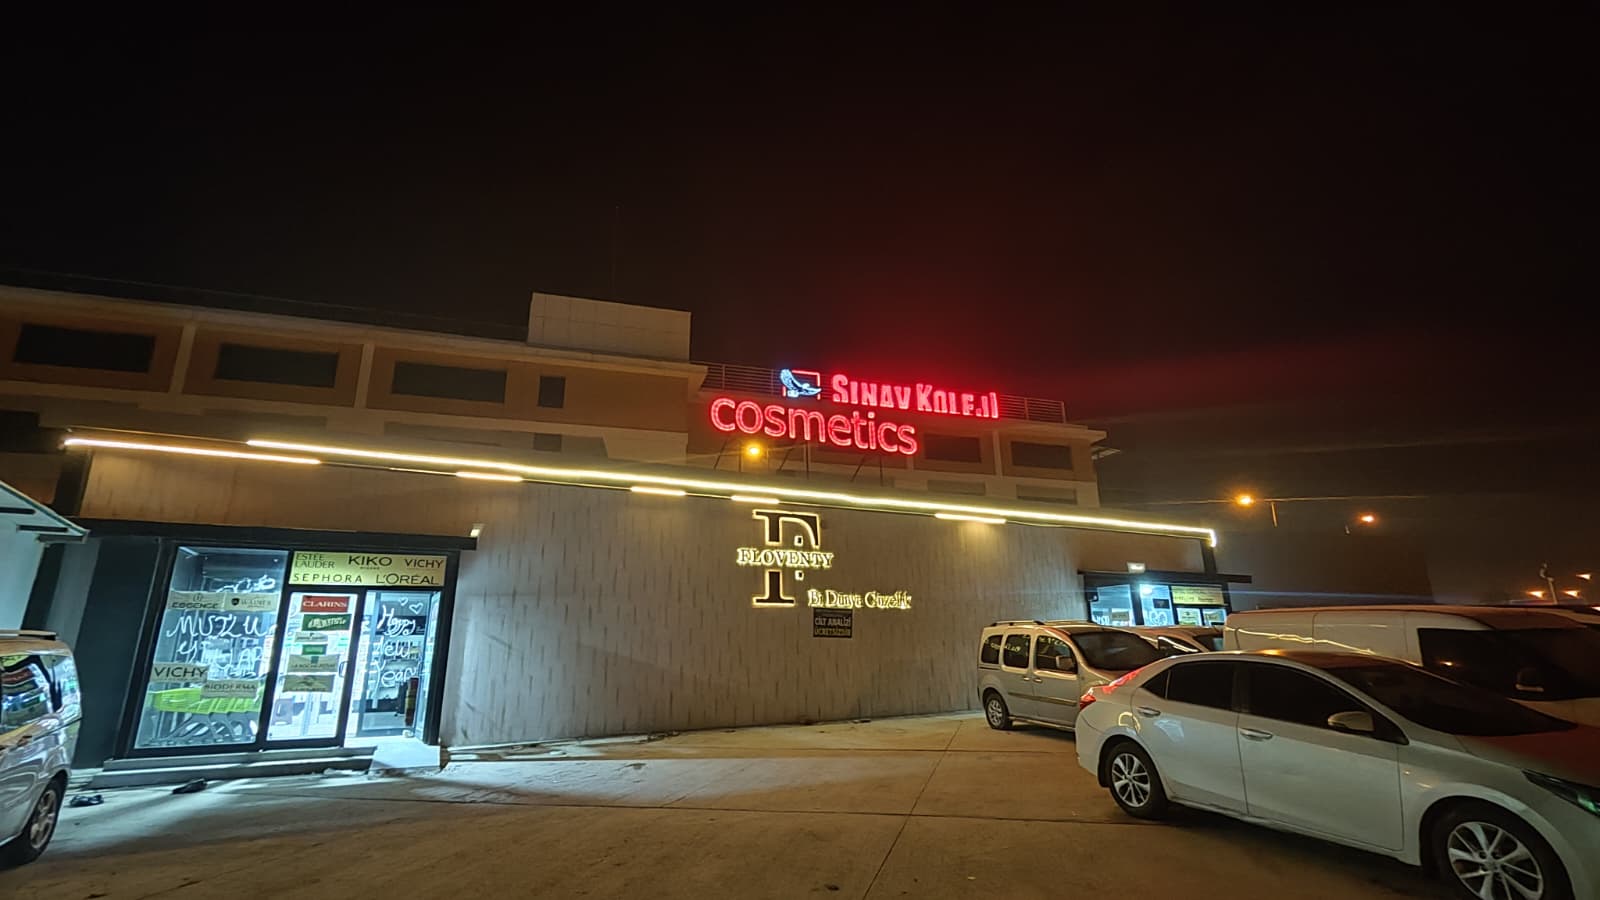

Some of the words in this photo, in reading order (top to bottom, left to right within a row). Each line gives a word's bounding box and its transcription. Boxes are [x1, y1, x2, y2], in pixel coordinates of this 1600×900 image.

[832, 373, 911, 410] SINAV
[710, 397, 918, 455] cosmetics
[348, 555, 393, 567] KIKO
[404, 559, 444, 569] VICHY
[736, 547, 834, 569] FLOVENTY
[294, 560, 335, 569] LAUDER
[293, 573, 362, 583] SEPHORA
[302, 600, 347, 608] CLARINS
[154, 666, 208, 678] VICHY
